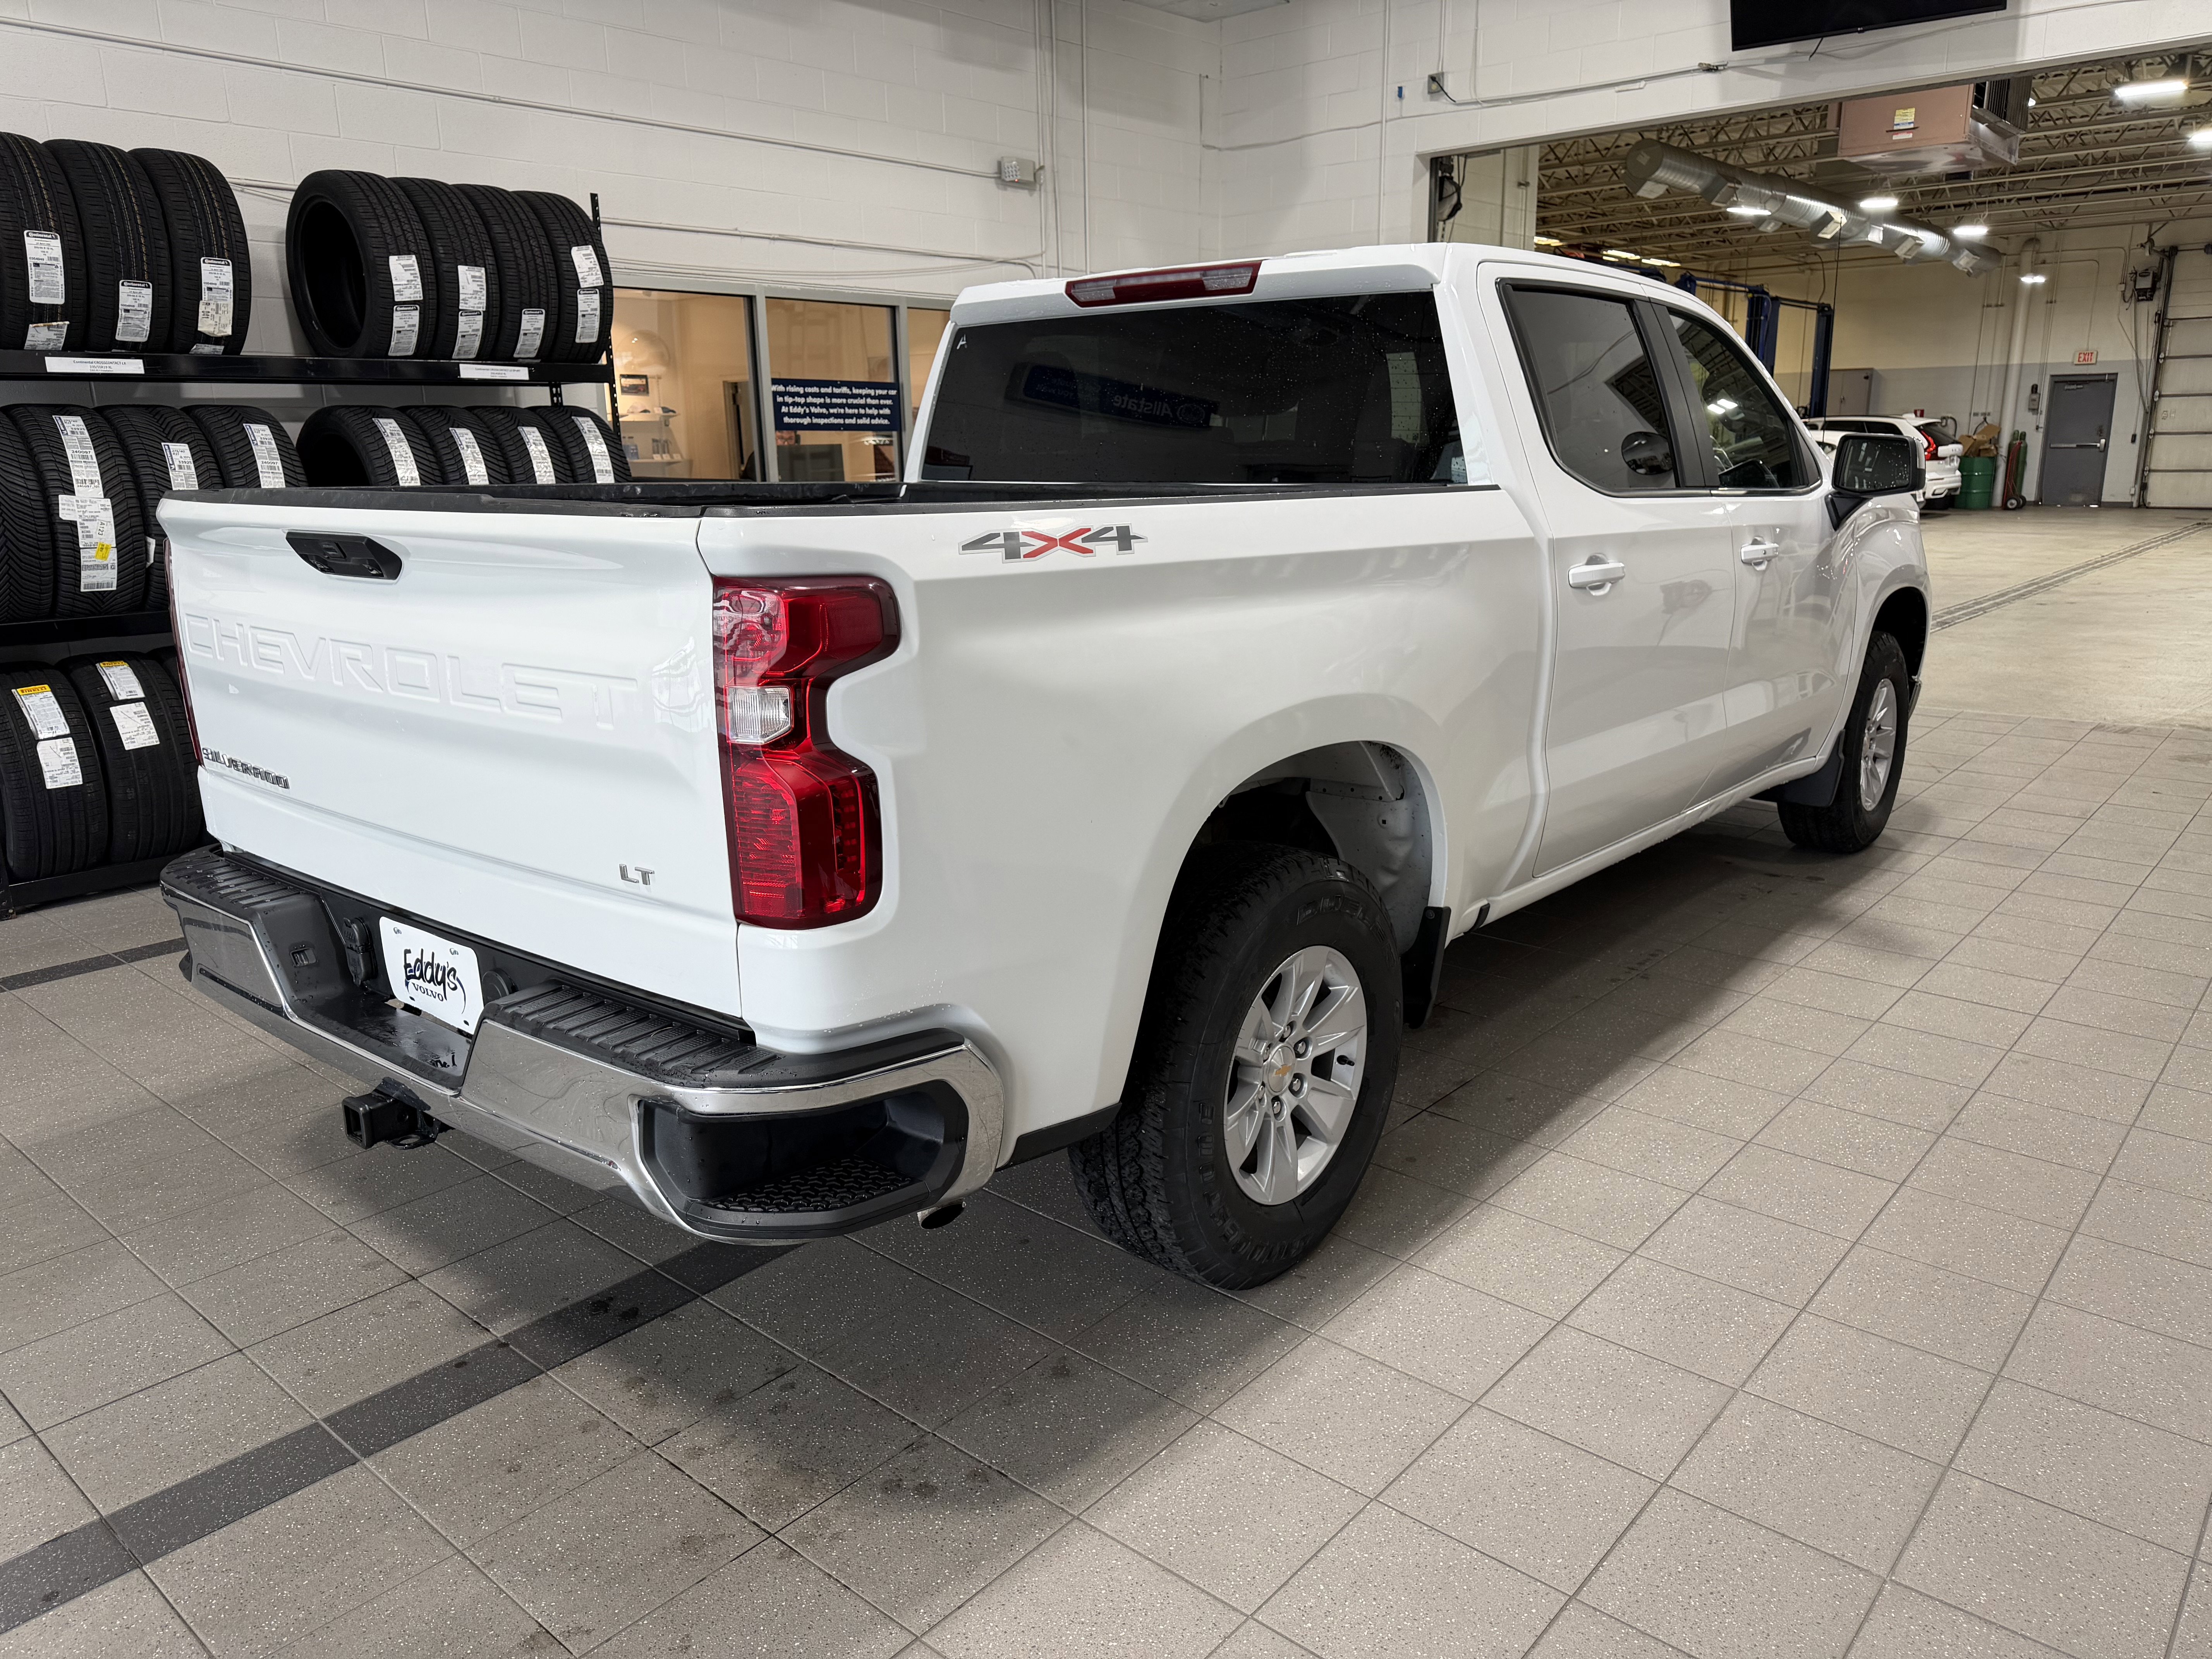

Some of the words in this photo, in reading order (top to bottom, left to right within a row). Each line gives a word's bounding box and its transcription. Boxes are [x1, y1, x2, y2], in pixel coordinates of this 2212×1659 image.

[2078, 352, 2094, 362] EXIT
[786, 385, 804, 394] rising
[833, 386, 852, 394] tariffs,
[852, 386, 875, 396] keeping
[784, 395, 805, 404] tip-top
[806, 396, 824, 404] shape
[789, 406, 810, 414] Eddy's
[810, 406, 828, 414] Volvo,
[866, 407, 878, 416] help
[783, 416, 812, 425] thorough
[812, 416, 844, 425] inspections
[185, 612, 638, 730] CHEVROLET
[202, 747, 290, 790] SILVERADO
[619, 864, 655, 886] LT
[404, 948, 458, 1001] Eddy's
[411, 982, 444, 1002] VOLVO
